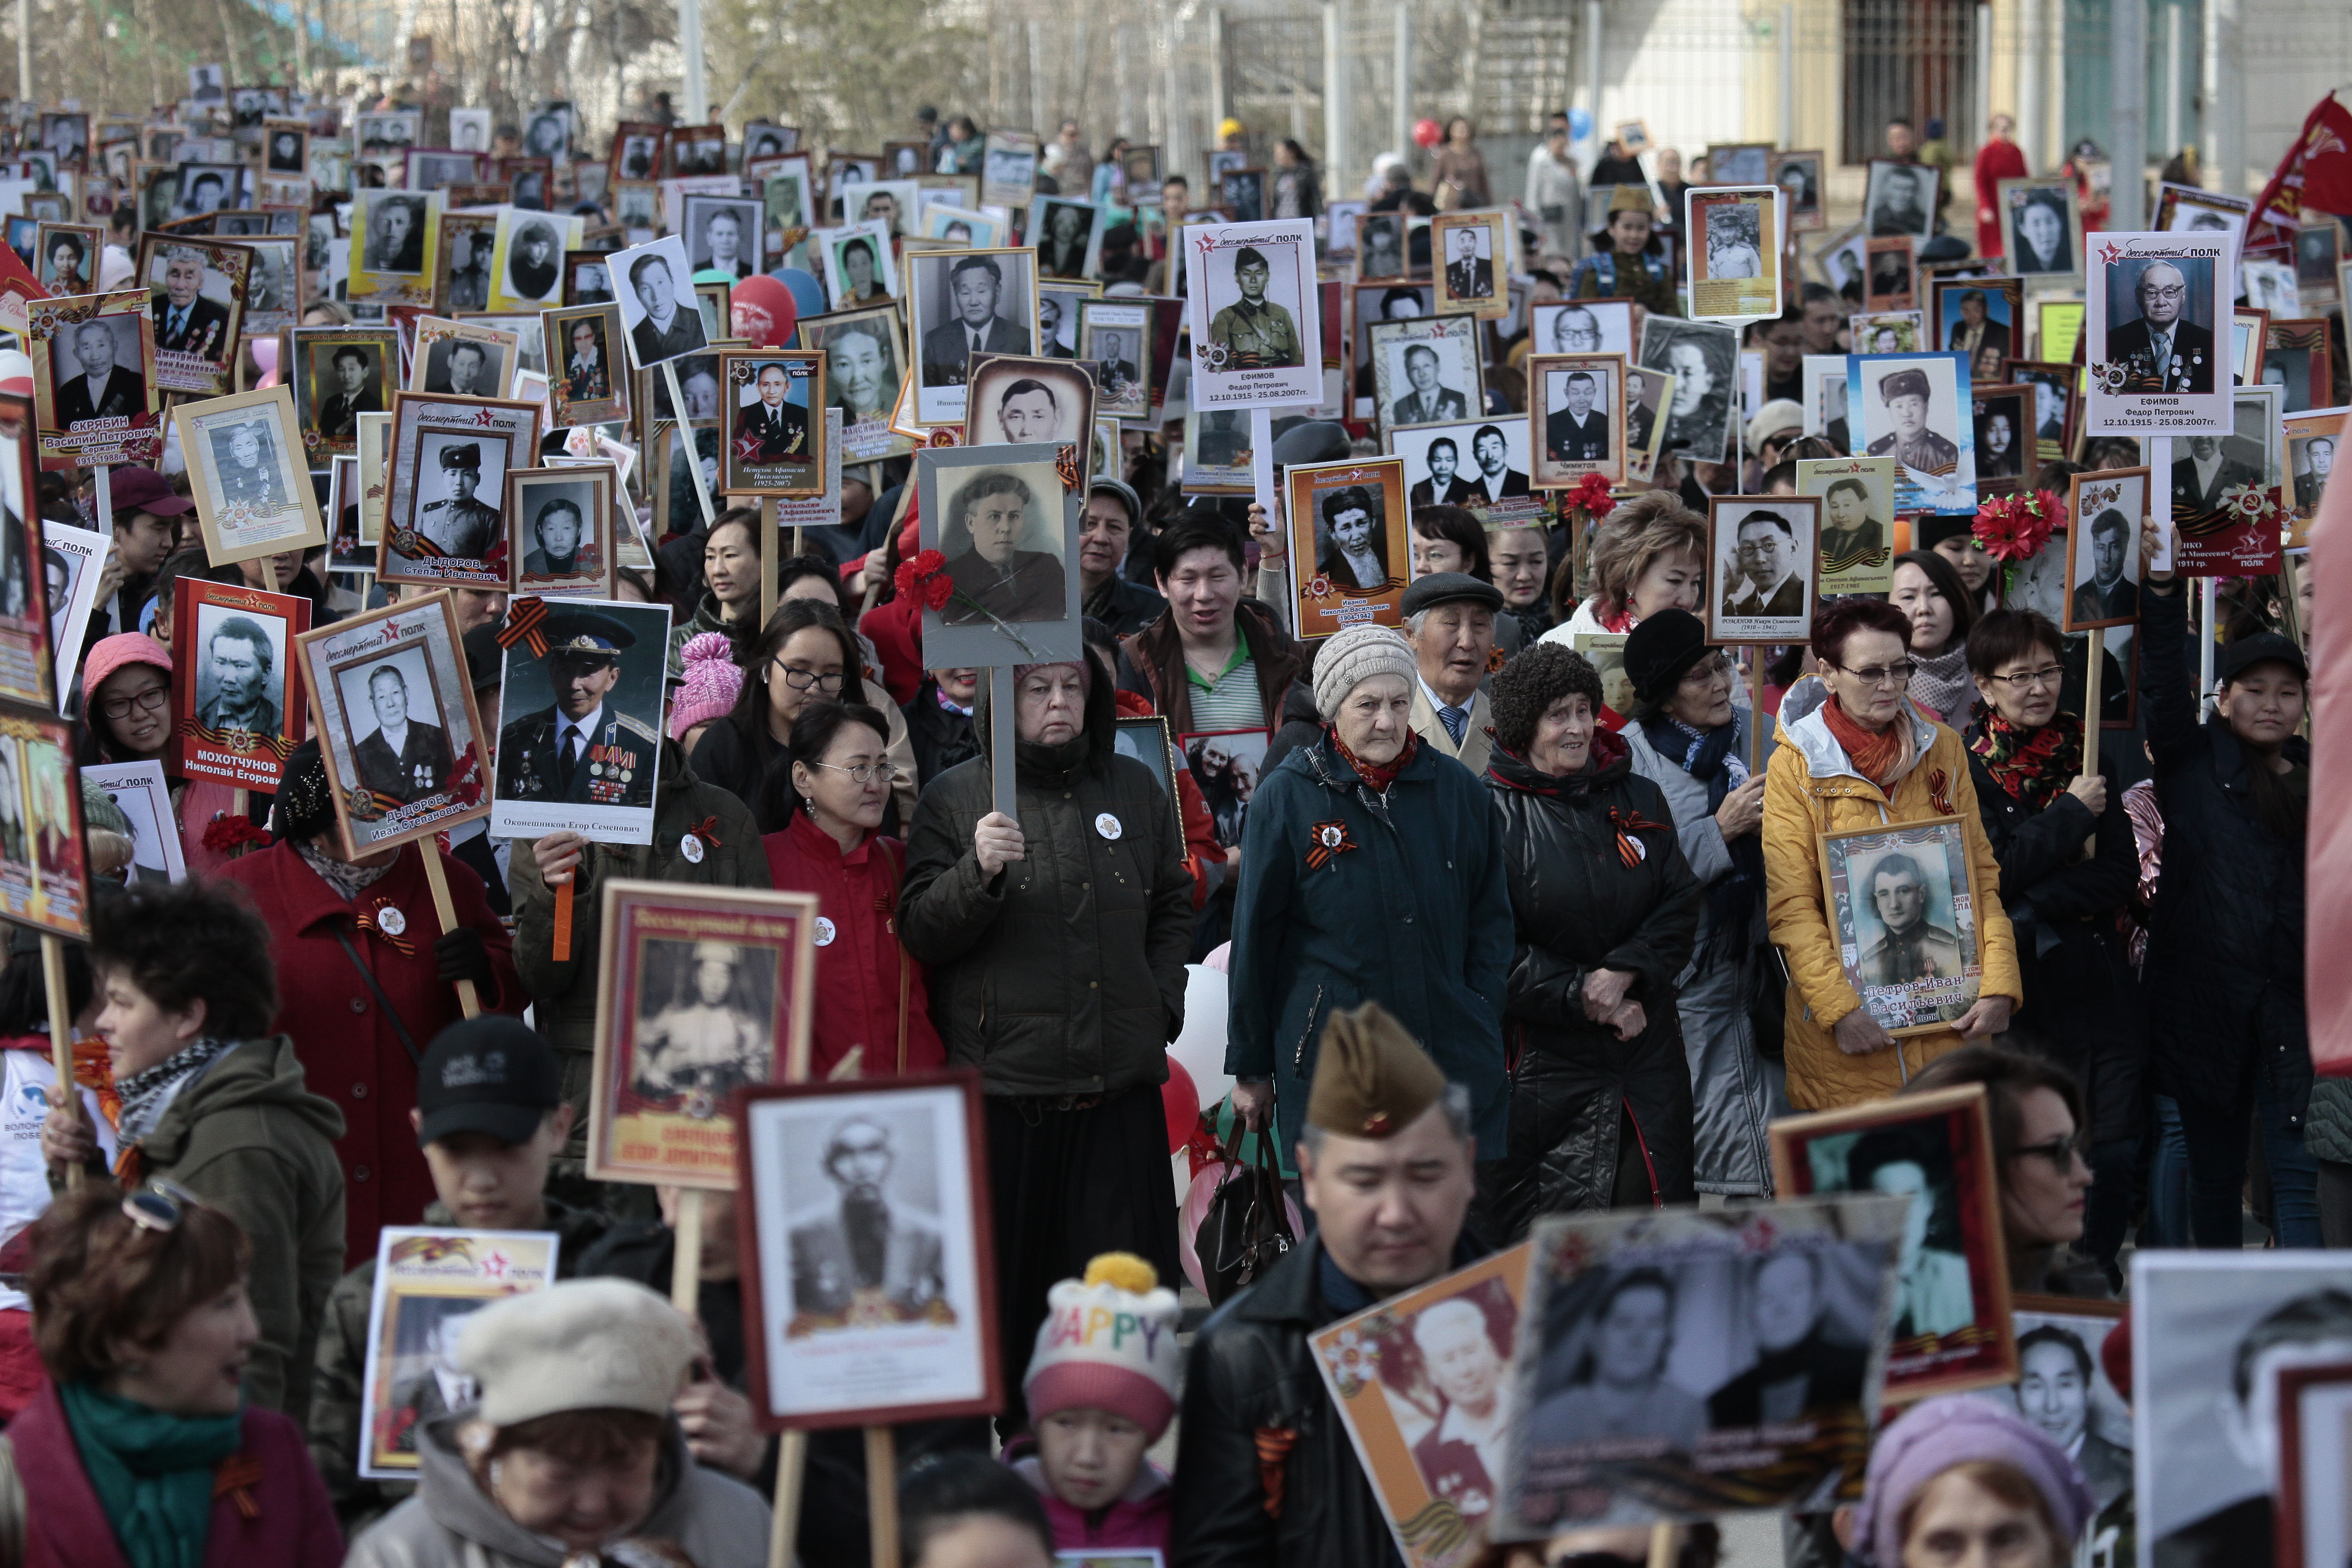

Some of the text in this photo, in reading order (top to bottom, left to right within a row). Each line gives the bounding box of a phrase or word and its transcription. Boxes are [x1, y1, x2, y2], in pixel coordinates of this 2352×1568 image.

[1276, 234, 1303, 243] ПОЛК
[2125, 239, 2220, 260] бессмертный ПОЛК
[1253, 382, 1289, 391] Петрович
[1210, 393, 1252, 402] 12.10.1915
[417, 403, 516, 429] бессмертный ПОЛК
[2125, 408, 2194, 417] Федор Петрович
[70, 415, 129, 433] СКРЯБИН
[45, 428, 156, 449] Василий Петрович
[81, 444, 121, 454] Сержант
[76, 454, 128, 466] 1915-1988гг.
[62, 541, 94, 557] ПОЛК
[423, 556, 480, 569] ДЫДОРОВ
[403, 565, 498, 582] Степан Иванович
[206, 586, 276, 611] бессмертный ПОЛК
[1320, 603, 1390, 616] Николай Васильевич
[1337, 611, 1374, 623] (1904-1942)
[323, 622, 426, 662] бессмертный ПОЛК
[185, 759, 233, 778] Николай
[197, 750, 277, 773] МОХОТЧУНОВ
[126, 776, 154, 787] ПОЛК
[386, 794, 444, 824] ДЫДОРОВ
[371, 801, 466, 841] Иван Степанович
[503, 818, 640, 833] Оконешников Егор Семенович
[1866, 982, 1920, 998] Петров
[1925, 976, 1963, 990] Иван
[1870, 993, 1963, 1015] Васильевич
[1917, 1014, 1938, 1023] ПОЛК
